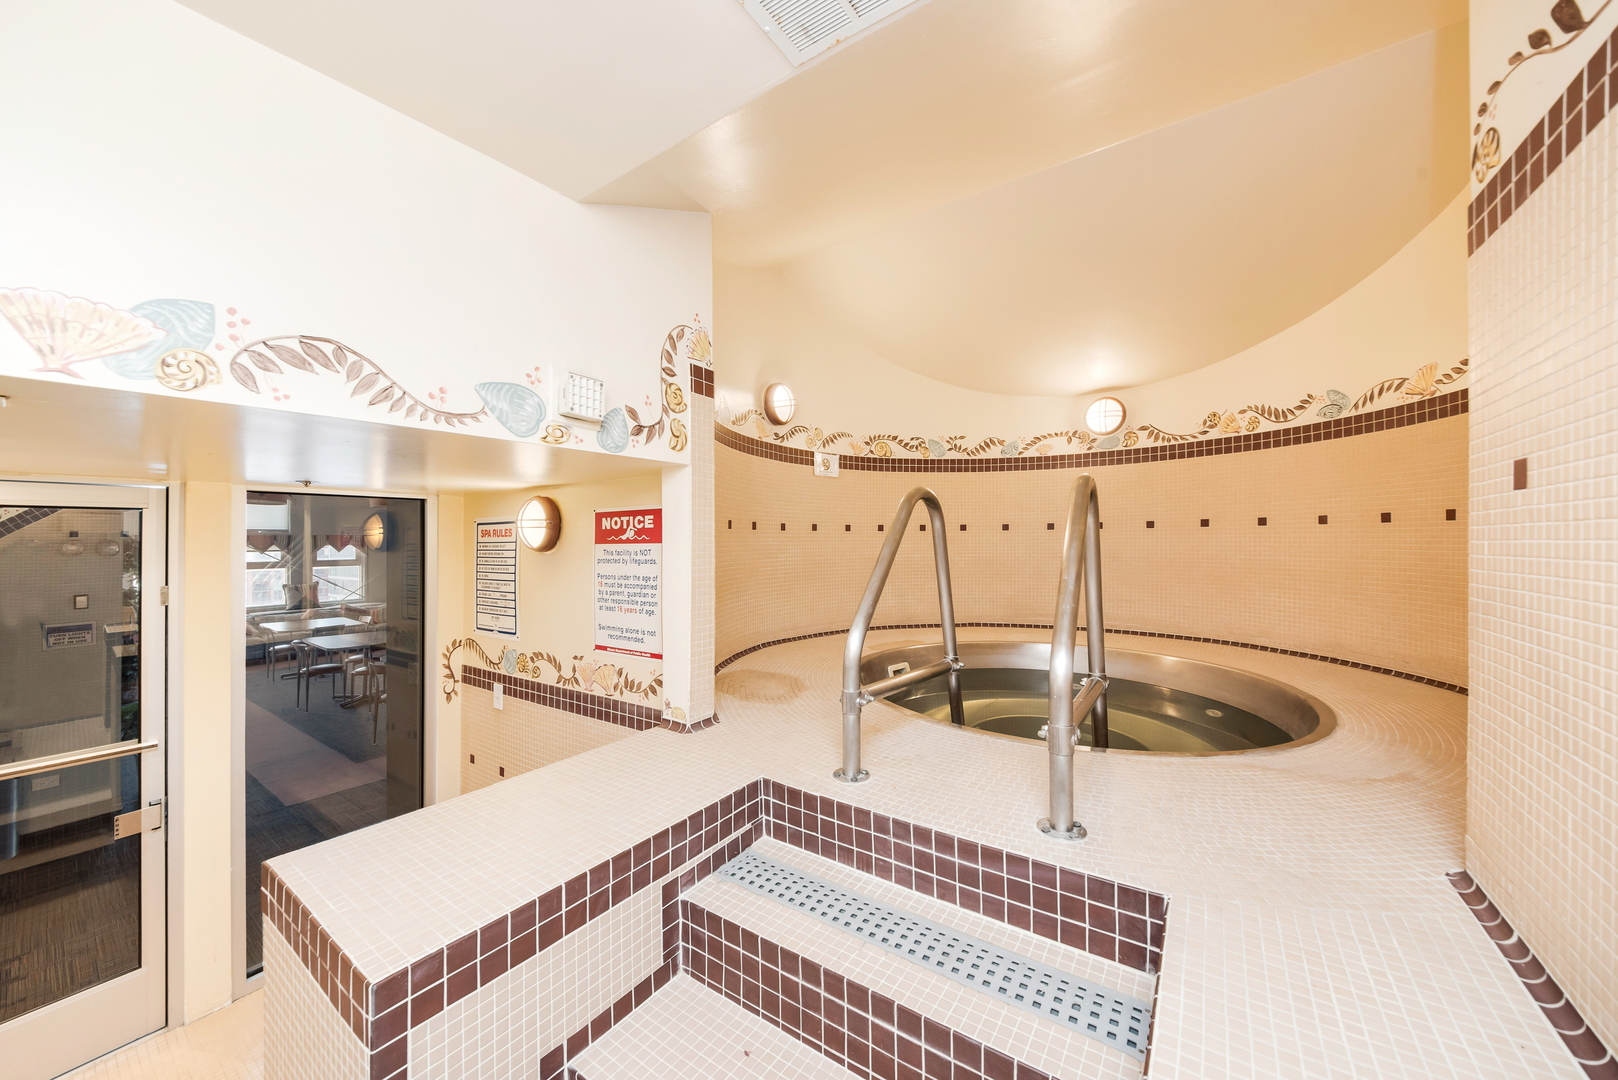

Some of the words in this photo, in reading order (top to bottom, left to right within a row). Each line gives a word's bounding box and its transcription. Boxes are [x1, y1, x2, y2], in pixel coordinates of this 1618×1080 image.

[601, 515, 654, 530] NOTICE
[480, 529, 492, 538] SPA
[492, 528, 513, 538] RULES
[614, 549, 632, 557] facility
[629, 558, 658, 566] lifeguards.
[623, 583, 658, 591] accompanied
[626, 591, 649, 599] guardian
[610, 598, 639, 606] responsible
[639, 600, 658, 608] person
[604, 604, 616, 612] least
[623, 607, 638, 615] years
[638, 607, 645, 615] of
[645, 609, 657, 618] age.
[598, 623, 624, 634] Swimming
[624, 627, 640, 635] alone
[640, 628, 646, 636] is
[607, 633, 646, 643] recommended.
